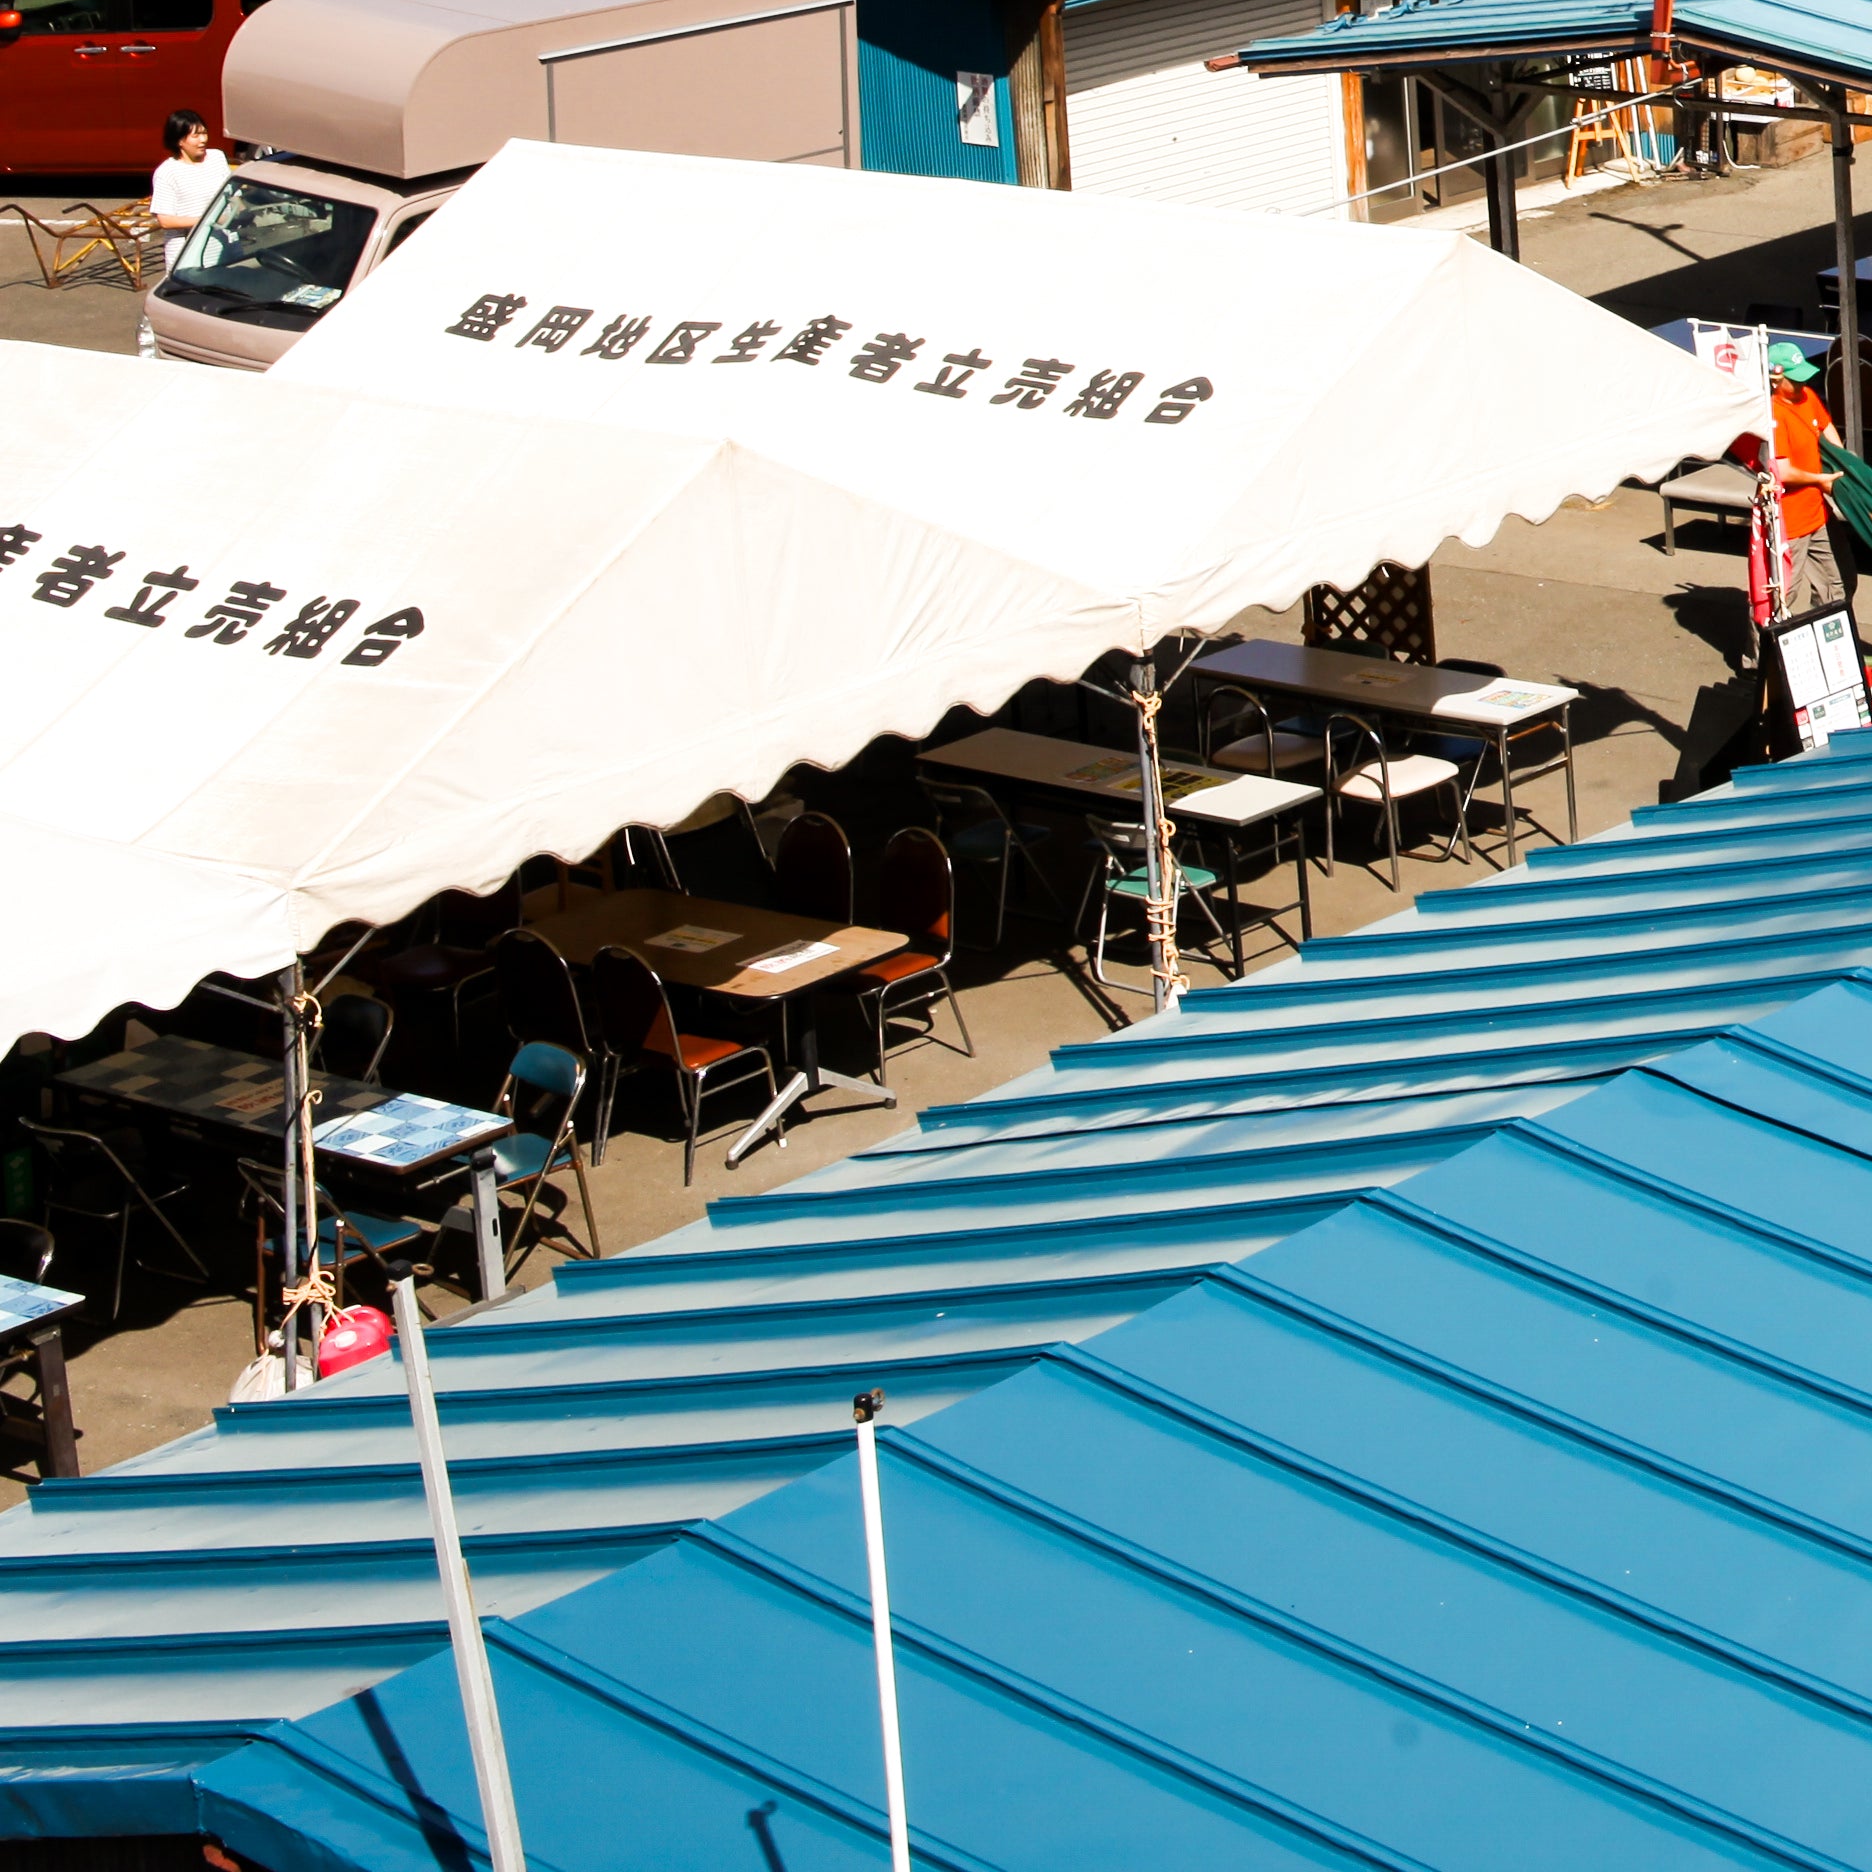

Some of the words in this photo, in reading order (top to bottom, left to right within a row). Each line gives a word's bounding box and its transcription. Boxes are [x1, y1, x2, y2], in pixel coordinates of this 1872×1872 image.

[446, 293, 1214, 425] 盛岡地区生産者立売組合
